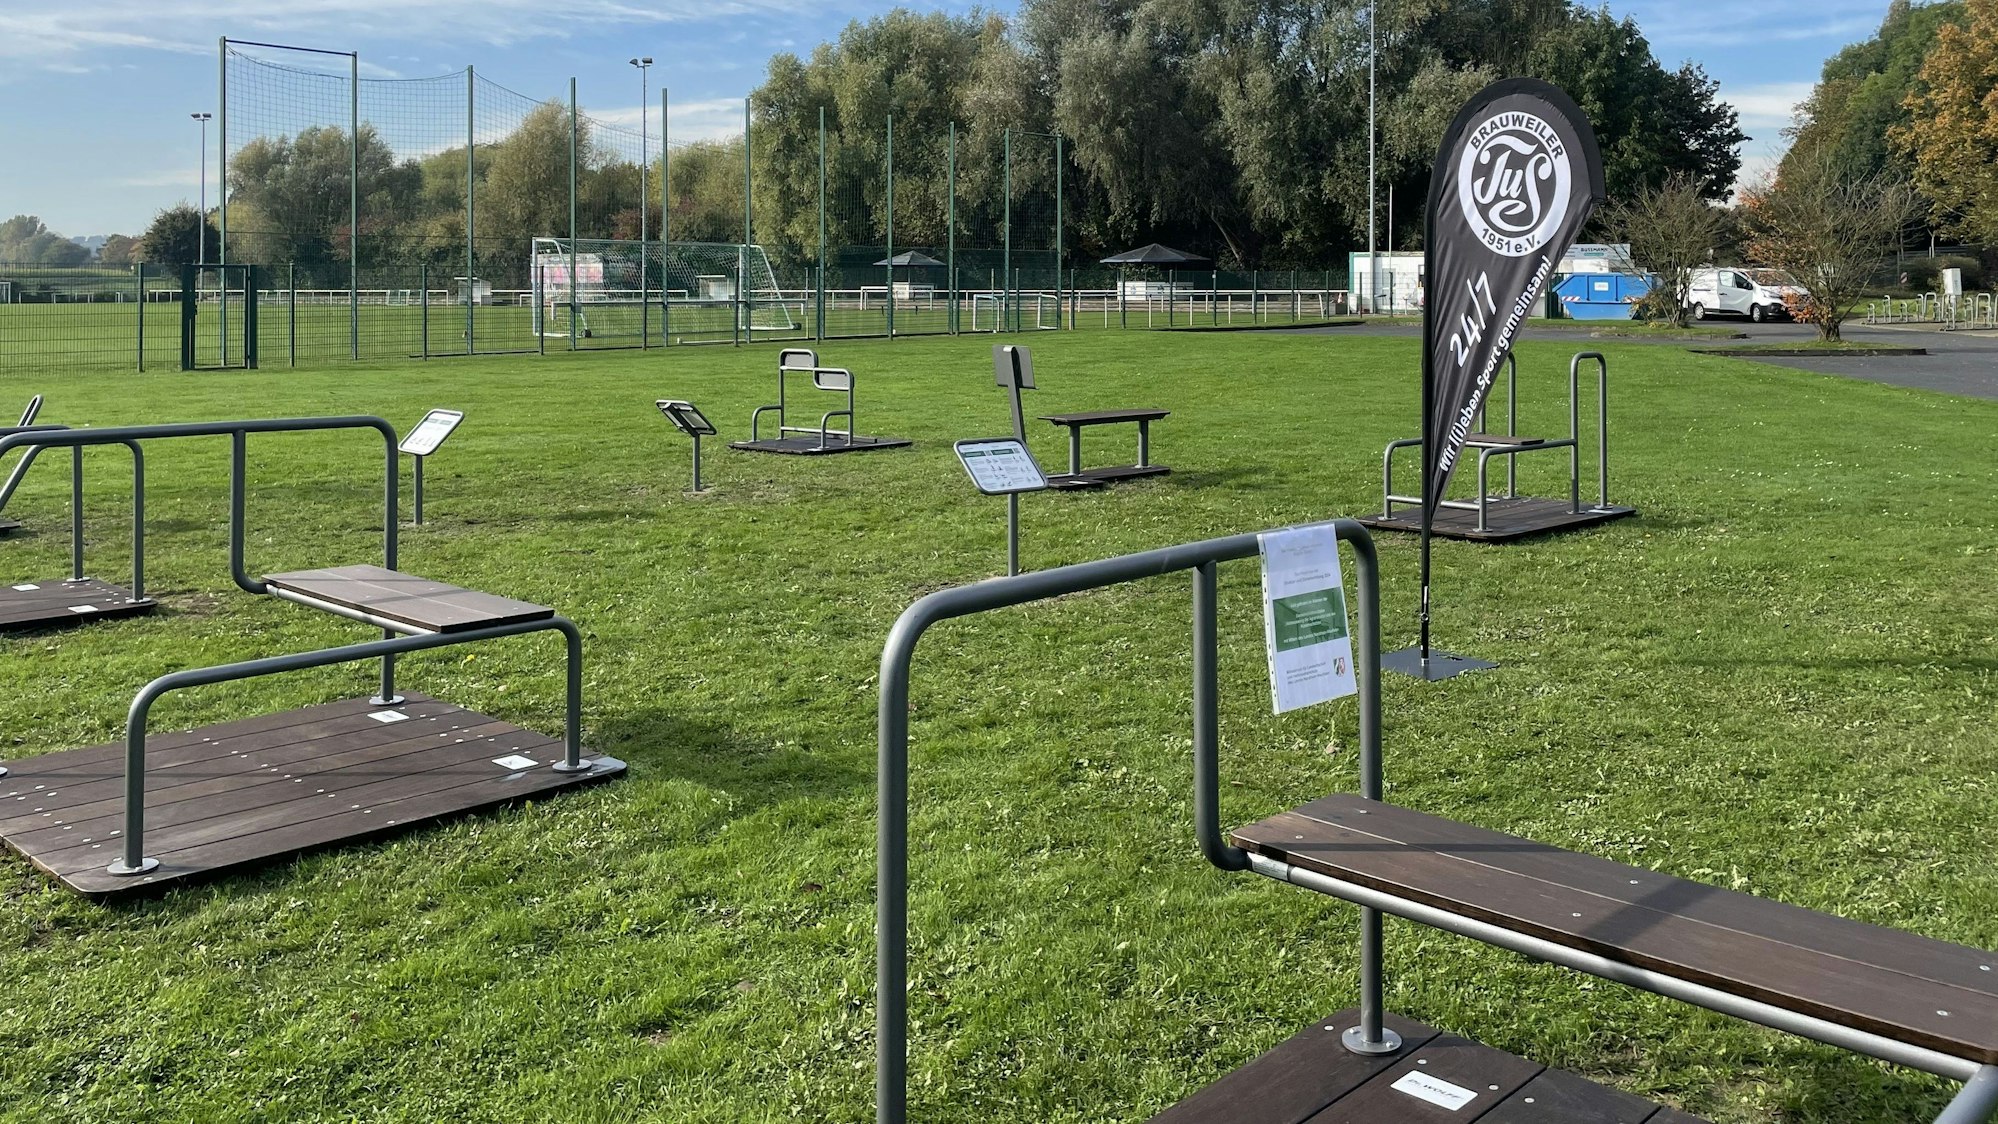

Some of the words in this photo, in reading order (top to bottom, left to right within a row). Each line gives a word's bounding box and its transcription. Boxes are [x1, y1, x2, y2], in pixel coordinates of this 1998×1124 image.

[1470, 114, 1564, 160] BRAUWEILER
[1473, 134, 1553, 232] TuS
[1482, 227, 1511, 253] 1951
[1515, 235, 1541, 253] e.V.
[1449, 271, 1497, 368] 24/7
[1476, 346, 1501, 390] Sport
[1497, 255, 1553, 351] gemeinsam!
